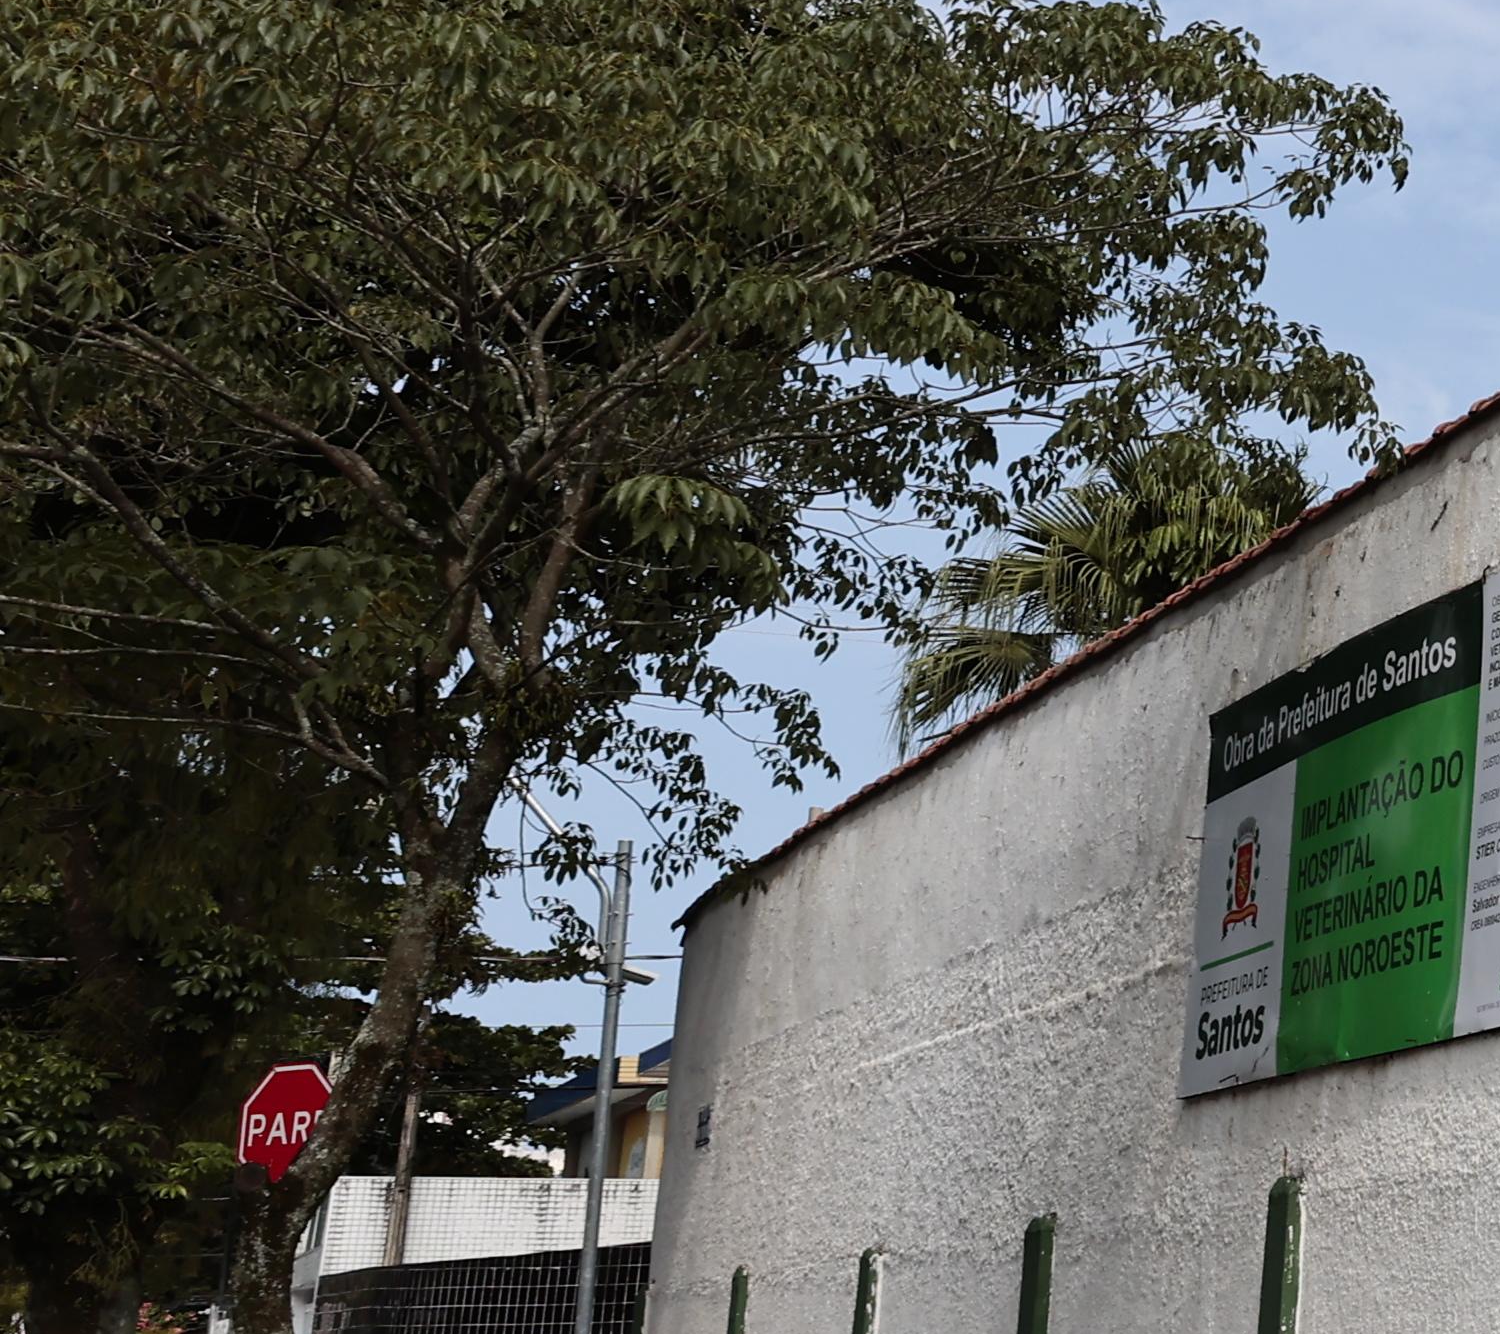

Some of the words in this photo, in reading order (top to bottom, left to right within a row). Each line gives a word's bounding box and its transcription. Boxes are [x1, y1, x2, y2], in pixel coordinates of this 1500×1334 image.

[1224, 731, 1254, 771] Obra
[1258, 716, 1274, 754] da
[1277, 680, 1351, 743] Prefeitura
[1355, 663, 1377, 704] de
[1382, 636, 1457, 692] Santos
[1300, 757, 1424, 841] IMPLANTAÇÃO
[1430, 750, 1464, 794] DO
[1297, 833, 1376, 893] HOSPITAL
[1476, 840, 1496, 860] STIER
[1295, 874, 1408, 944] VETERINÁRIO
[1413, 865, 1444, 908] DA
[1472, 893, 1500, 913] Salvador
[1200, 971, 1254, 1007] PREFEITURA
[1255, 966, 1269, 988] DE
[1290, 951, 1333, 997] ZONA
[1337, 920, 1444, 982] NOROESTE
[1195, 1004, 1266, 1061] Santos
